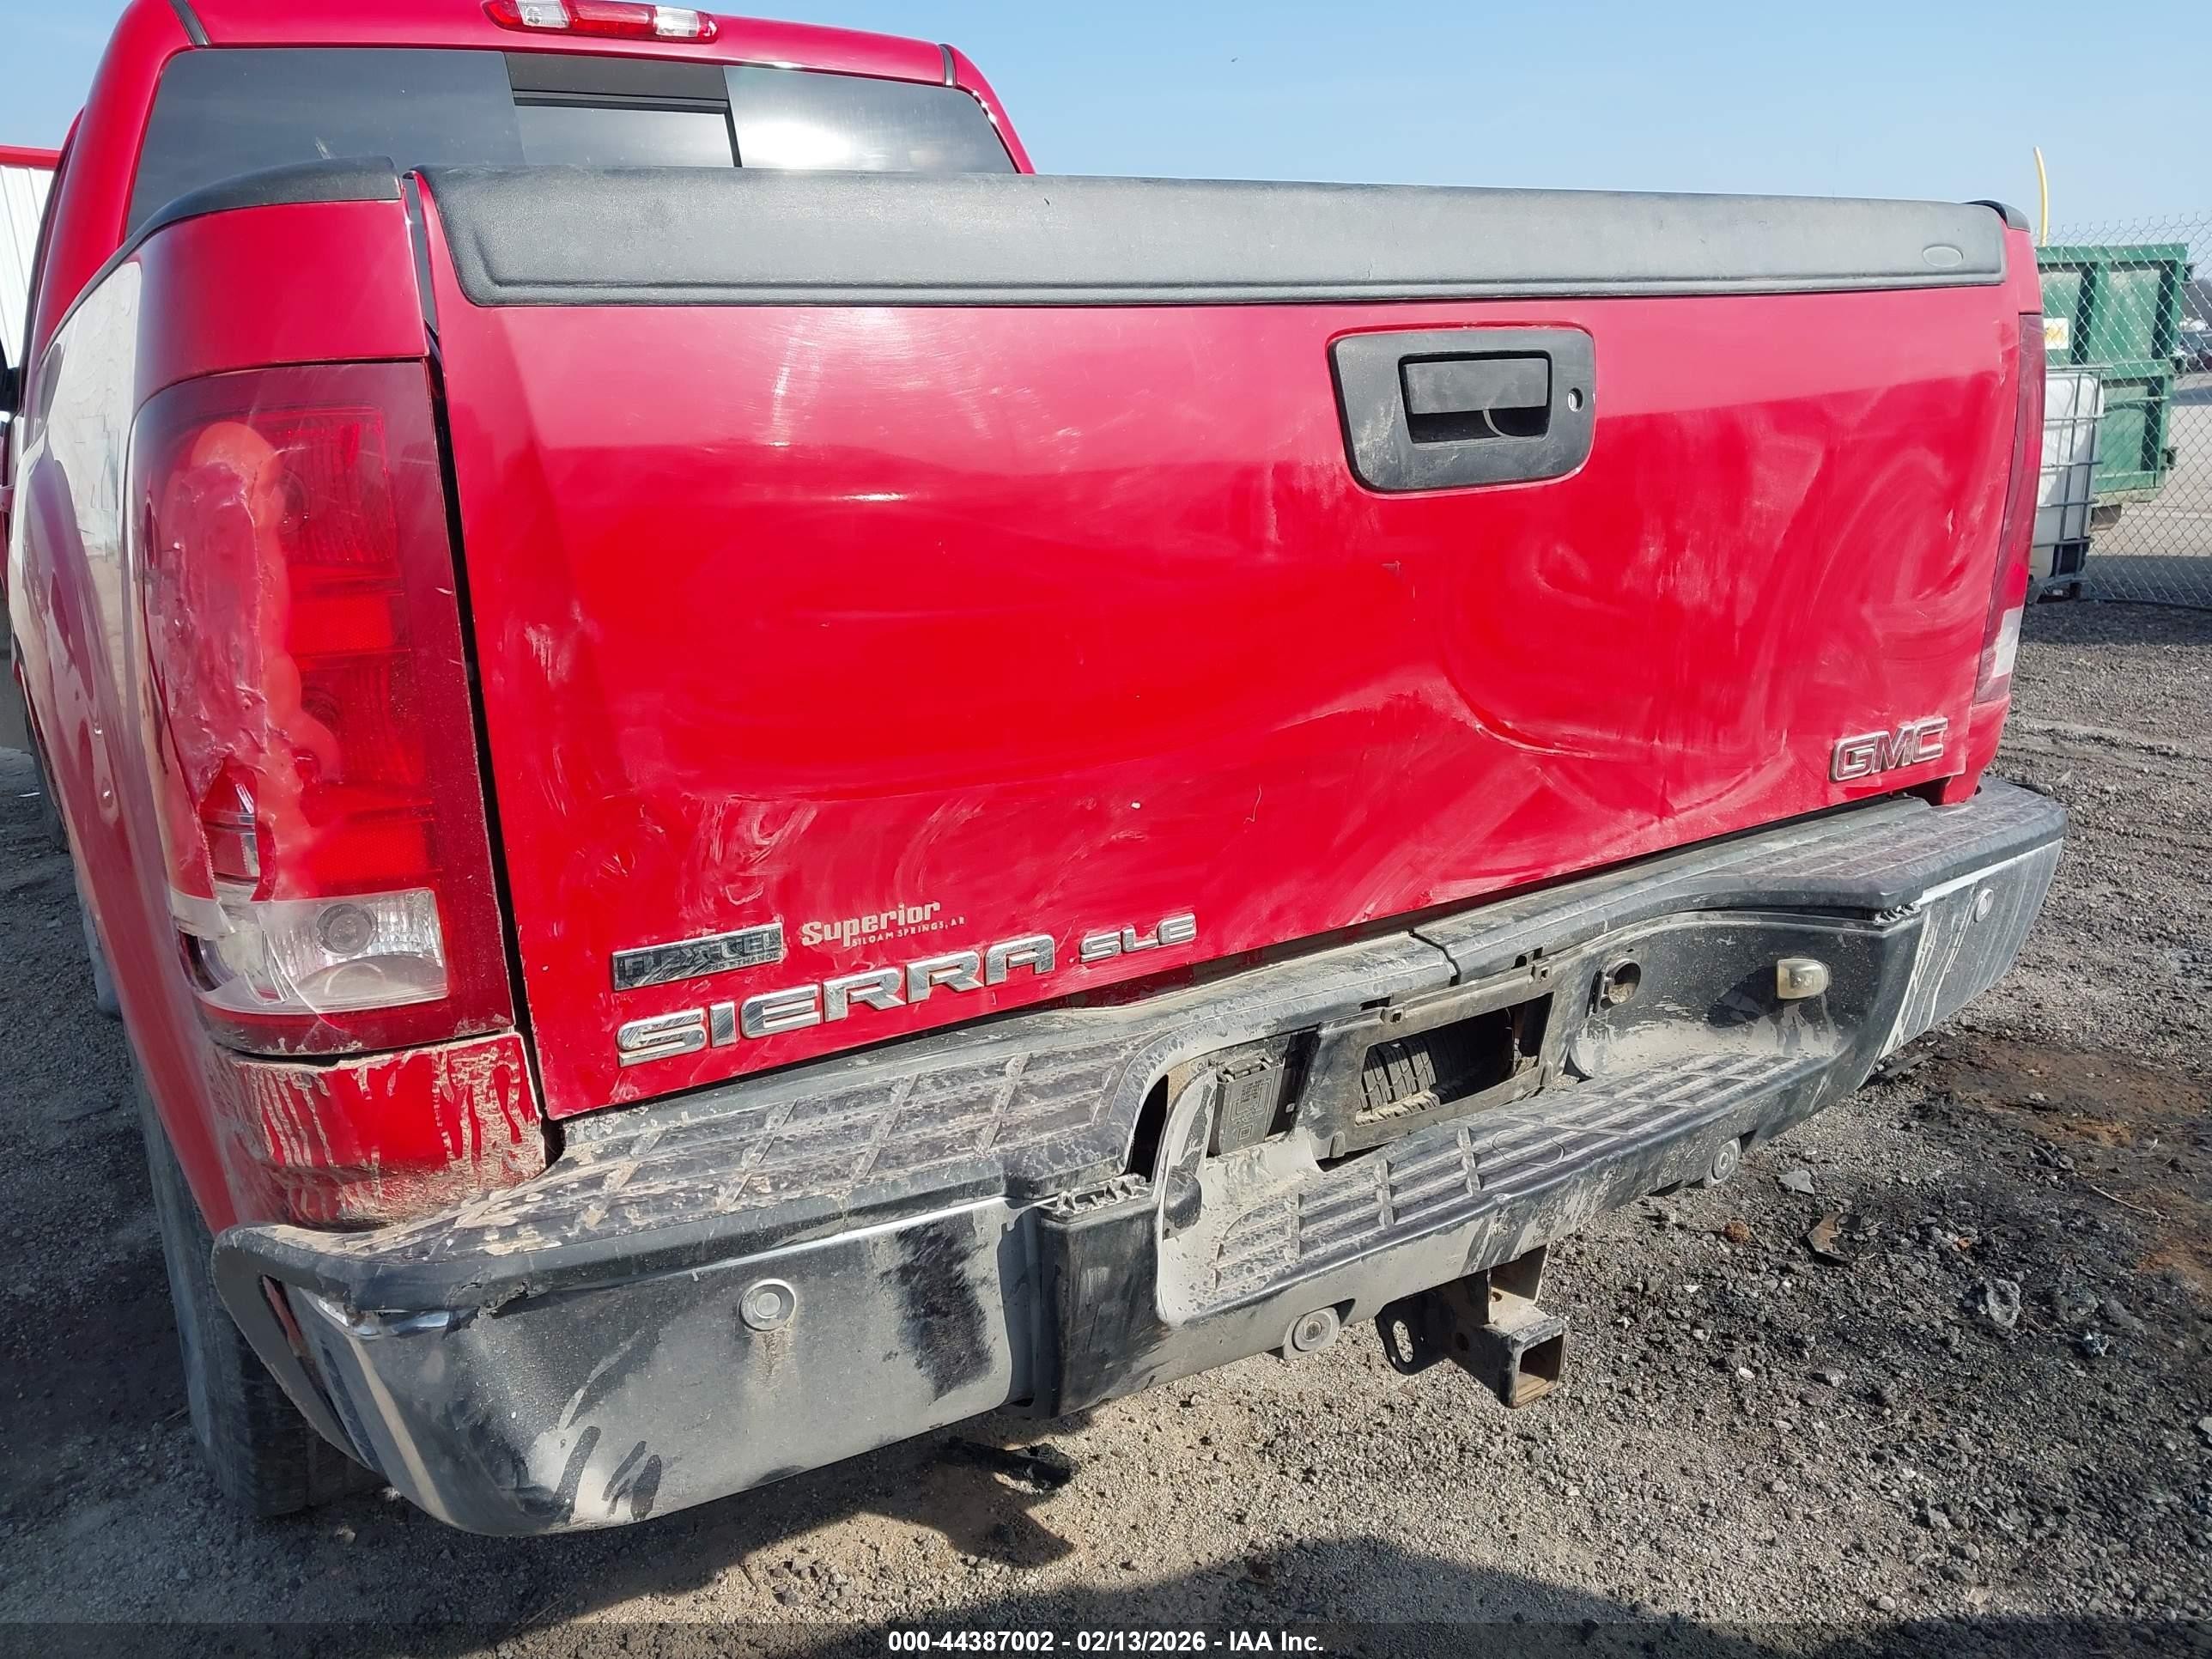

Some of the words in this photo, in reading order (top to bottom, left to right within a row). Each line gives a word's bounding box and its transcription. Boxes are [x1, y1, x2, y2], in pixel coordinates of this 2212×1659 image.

[1829, 717, 1948, 781] GMC
[801, 902, 941, 947] Superior
[851, 931, 894, 947] SILOAM
[951, 916, 965, 927] AR
[1080, 913, 1197, 963] SLE
[617, 933, 1055, 1066] SIERRA
